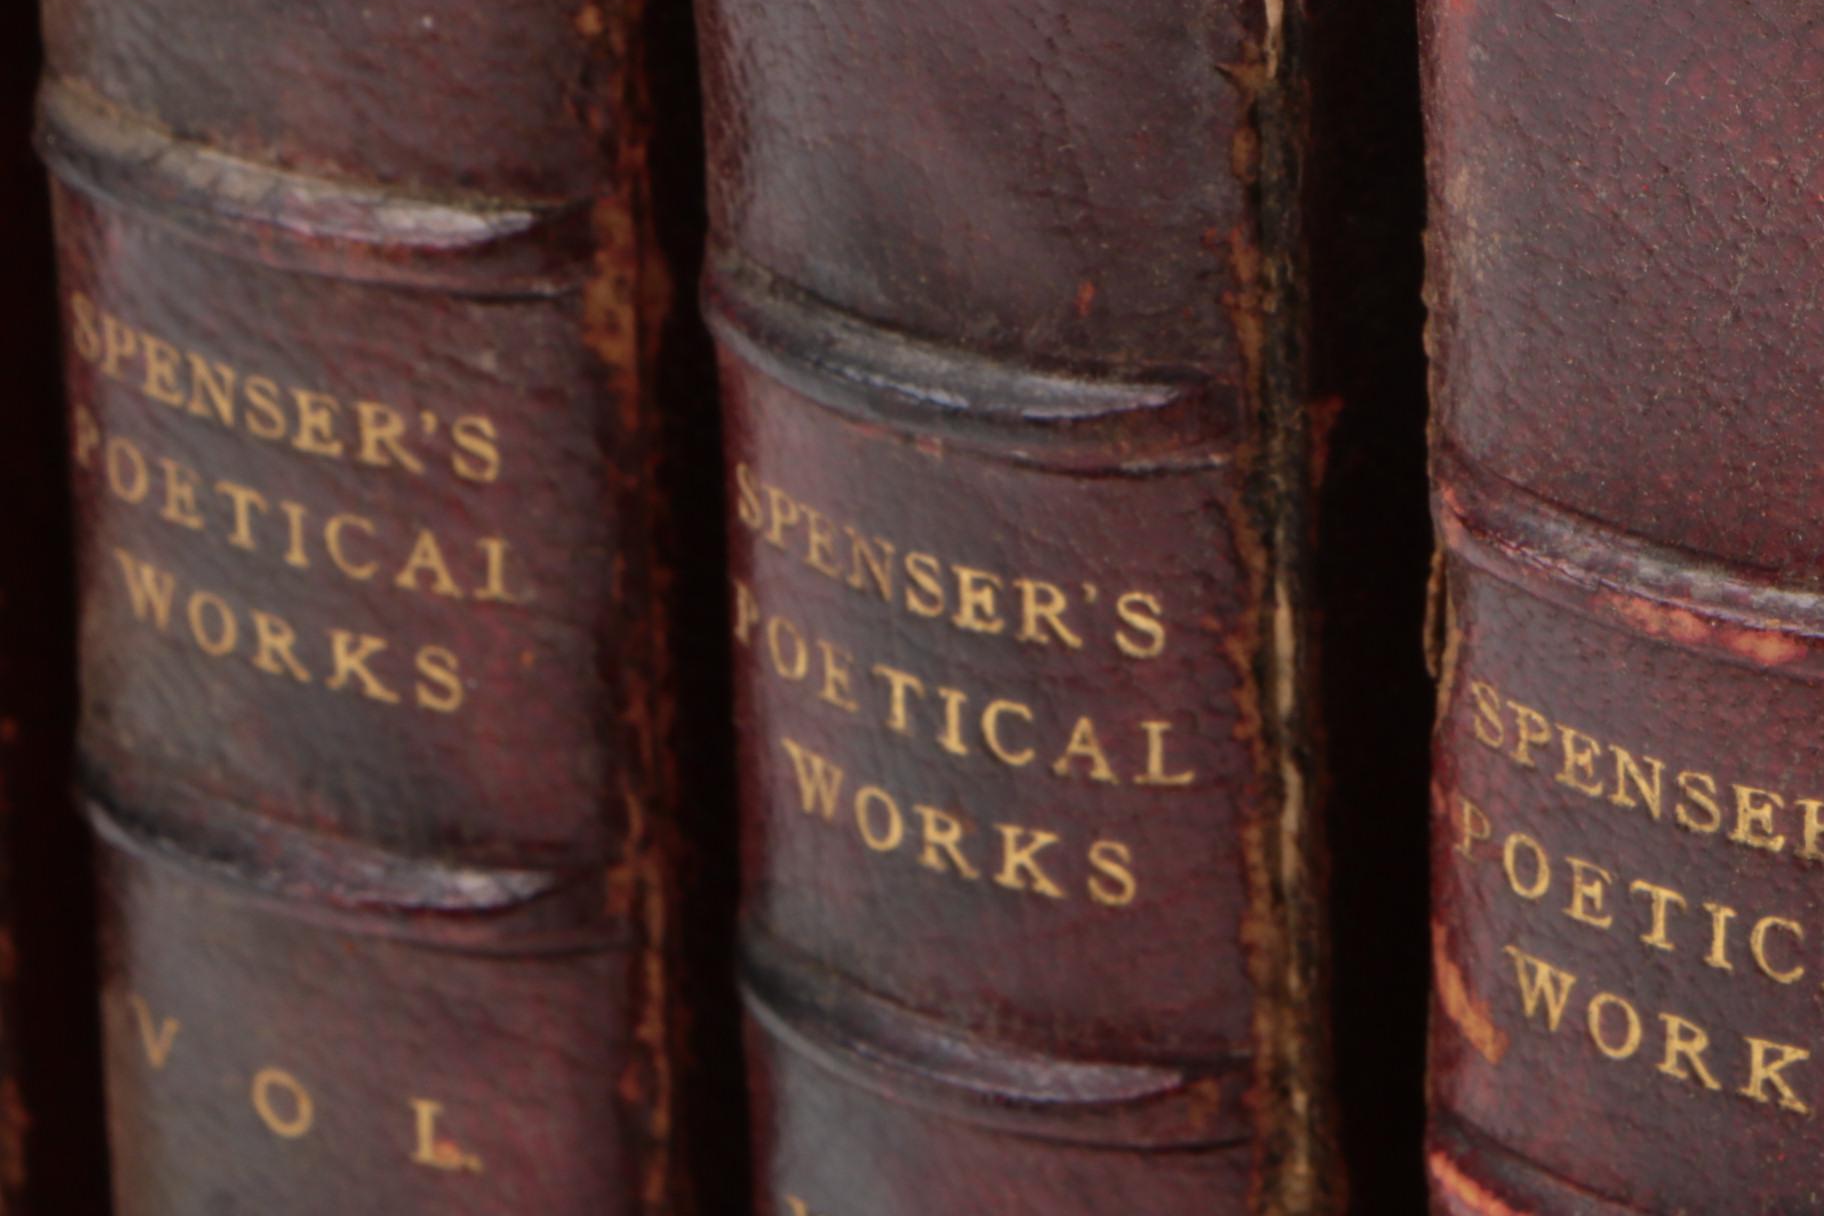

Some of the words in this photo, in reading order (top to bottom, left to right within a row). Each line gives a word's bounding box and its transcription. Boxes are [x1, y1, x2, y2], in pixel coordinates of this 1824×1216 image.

[71, 290, 502, 483] SPENSER'S
[73, 402, 540, 605] POETICAL
[735, 461, 1167, 659] SPENSER'S
[113, 547, 465, 713] WORKS
[733, 577, 1195, 786] POETICAL
[782, 736, 1138, 907] WORKS
